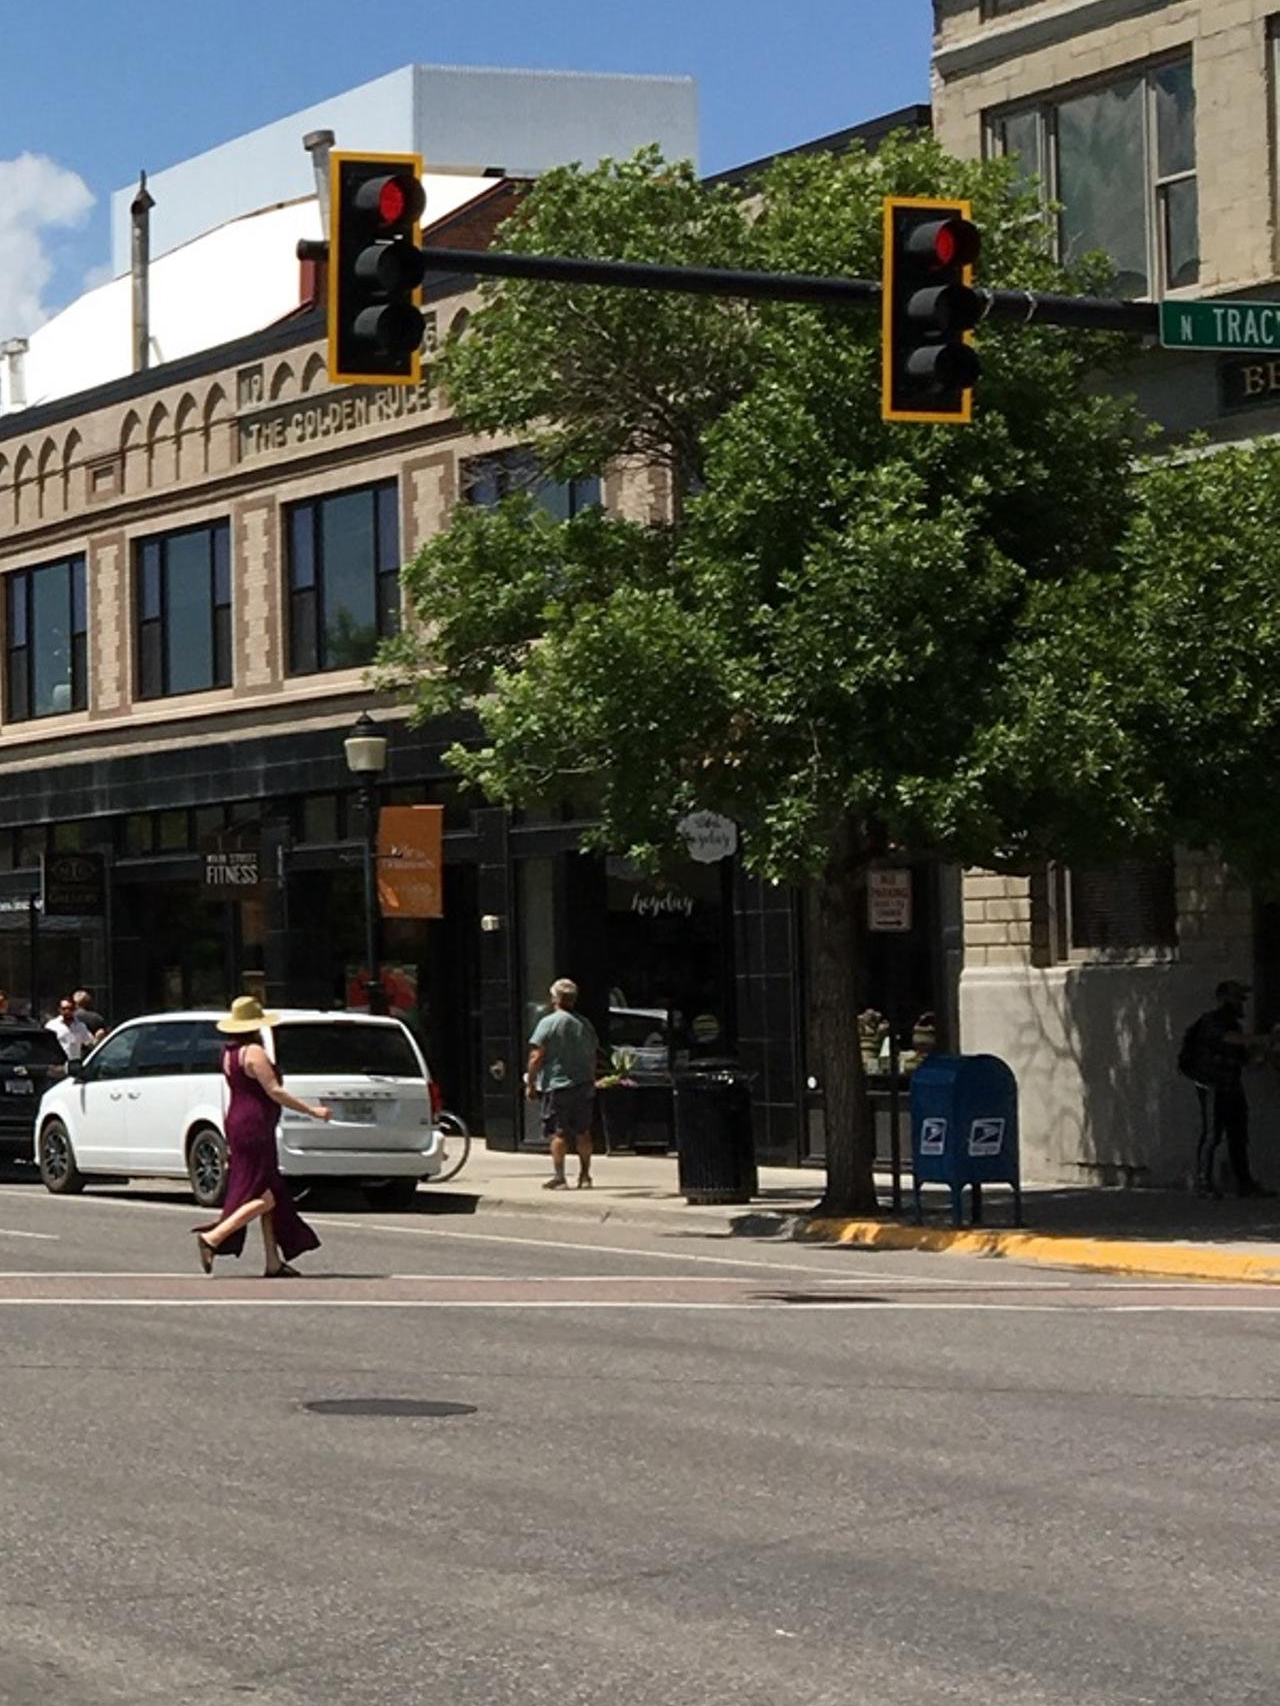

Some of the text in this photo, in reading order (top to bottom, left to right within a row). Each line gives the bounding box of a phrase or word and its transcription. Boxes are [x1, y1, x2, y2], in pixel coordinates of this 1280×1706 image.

[1180, 314, 1193, 342] N
[249, 379, 428, 453] THE GOLDEN RULE
[206, 864, 259, 886] FITNESS
[630, 892, 694, 917] heyday
